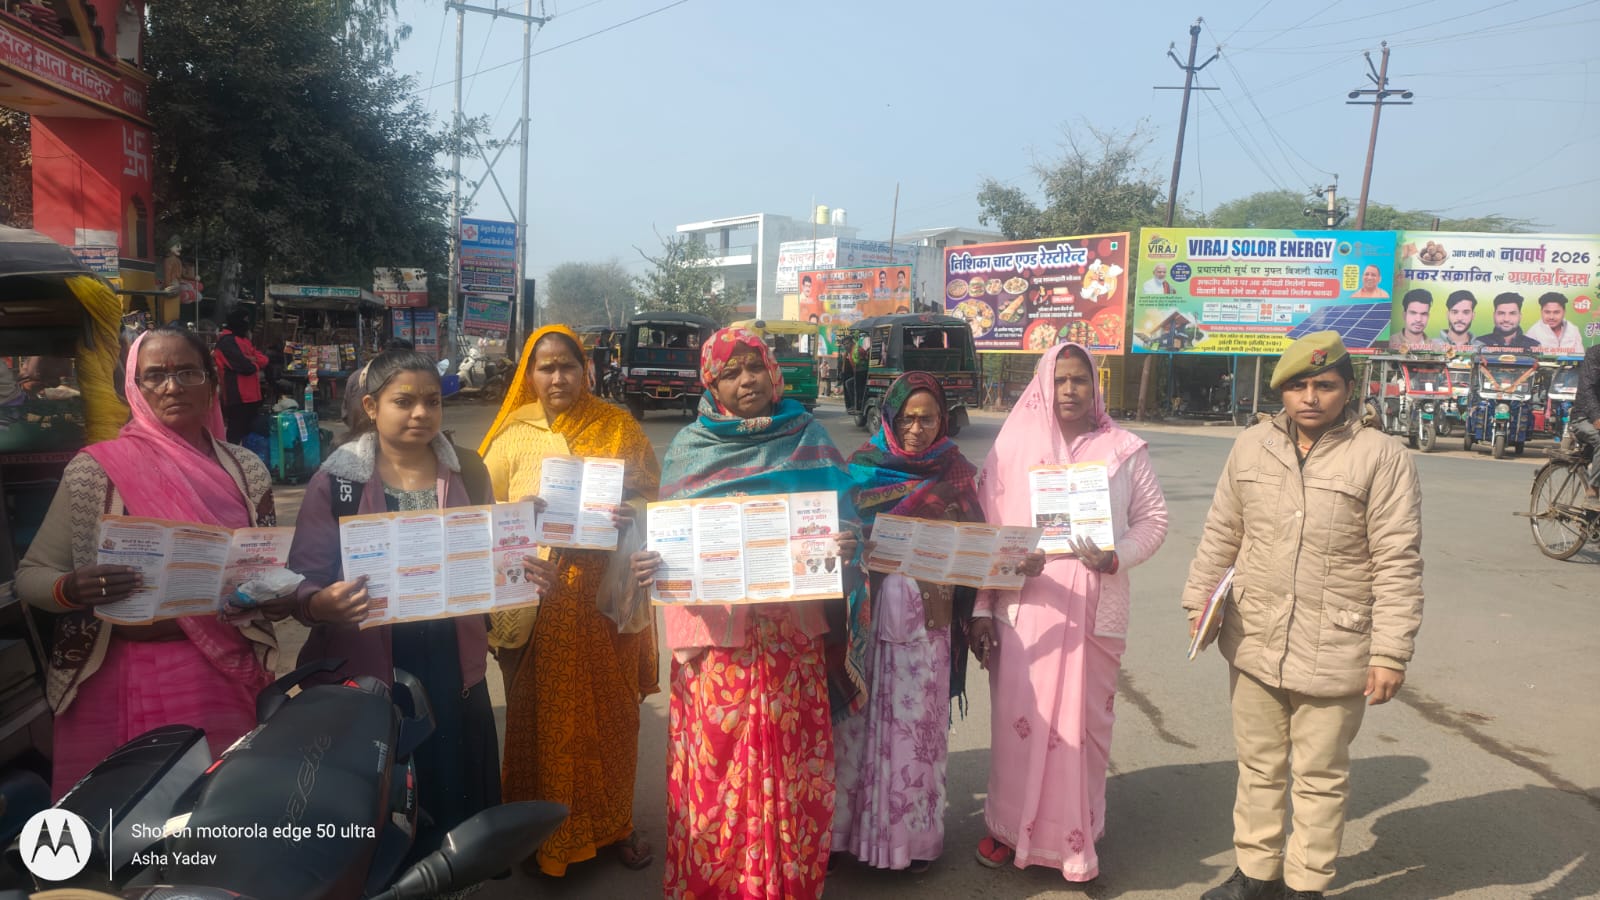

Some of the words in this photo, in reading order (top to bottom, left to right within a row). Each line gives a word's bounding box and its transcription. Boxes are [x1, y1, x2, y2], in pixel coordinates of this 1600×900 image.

[1148, 245, 1178, 254] VIRAJ
[1189, 240, 1228, 256] VIRAJ
[1231, 240, 1277, 257] SOLOR
[1280, 241, 1333, 258] ENERGY
[1500, 244, 1546, 263] नववर्ष
[1551, 251, 1590, 264] 2026
[993, 255, 1013, 268] चाट
[1404, 269, 1438, 281] मकर
[1554, 268, 1590, 287] दिवस
[382, 293, 408, 305] PSIT
